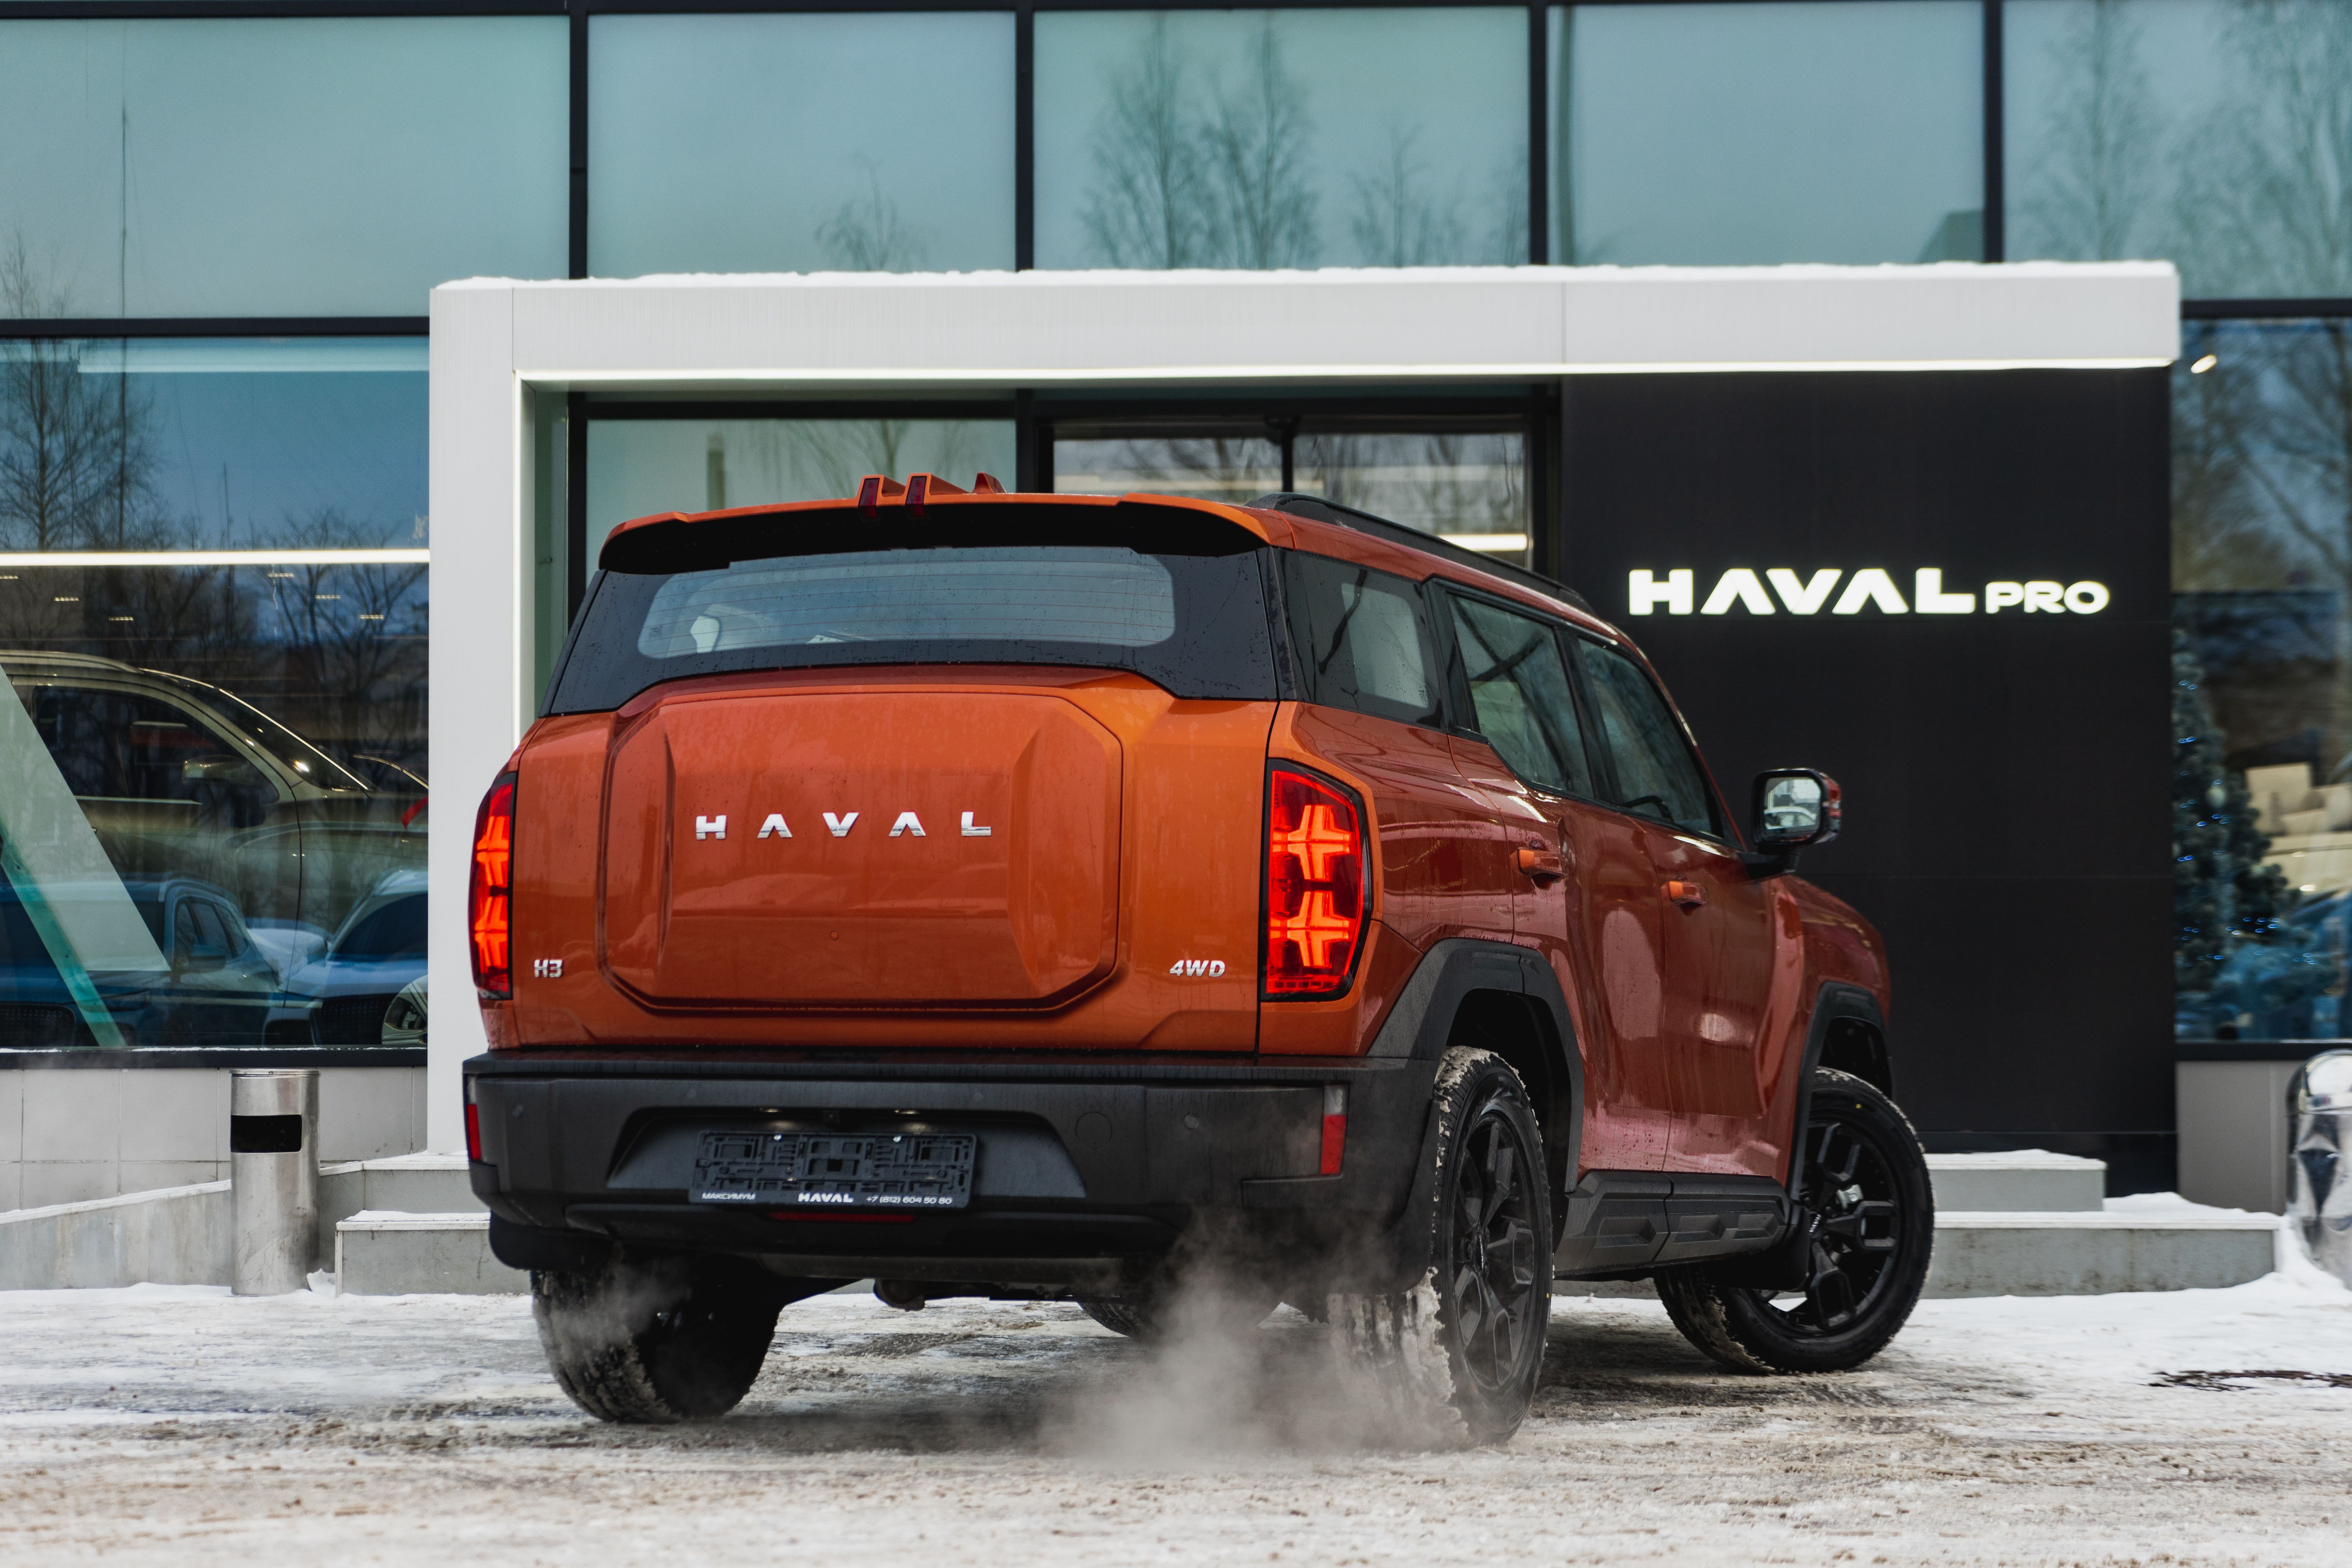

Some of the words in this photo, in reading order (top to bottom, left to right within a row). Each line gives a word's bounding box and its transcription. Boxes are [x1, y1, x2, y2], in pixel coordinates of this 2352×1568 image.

[1628, 567, 1976, 615] HAVAL
[1985, 581, 2110, 615] PRO
[696, 811, 992, 840] HAVAL
[534, 959, 563, 978] H3
[1169, 959, 1226, 977] 4WD
[797, 1192, 854, 1203] HAVAL
[879, 1196, 901, 1204] (812)
